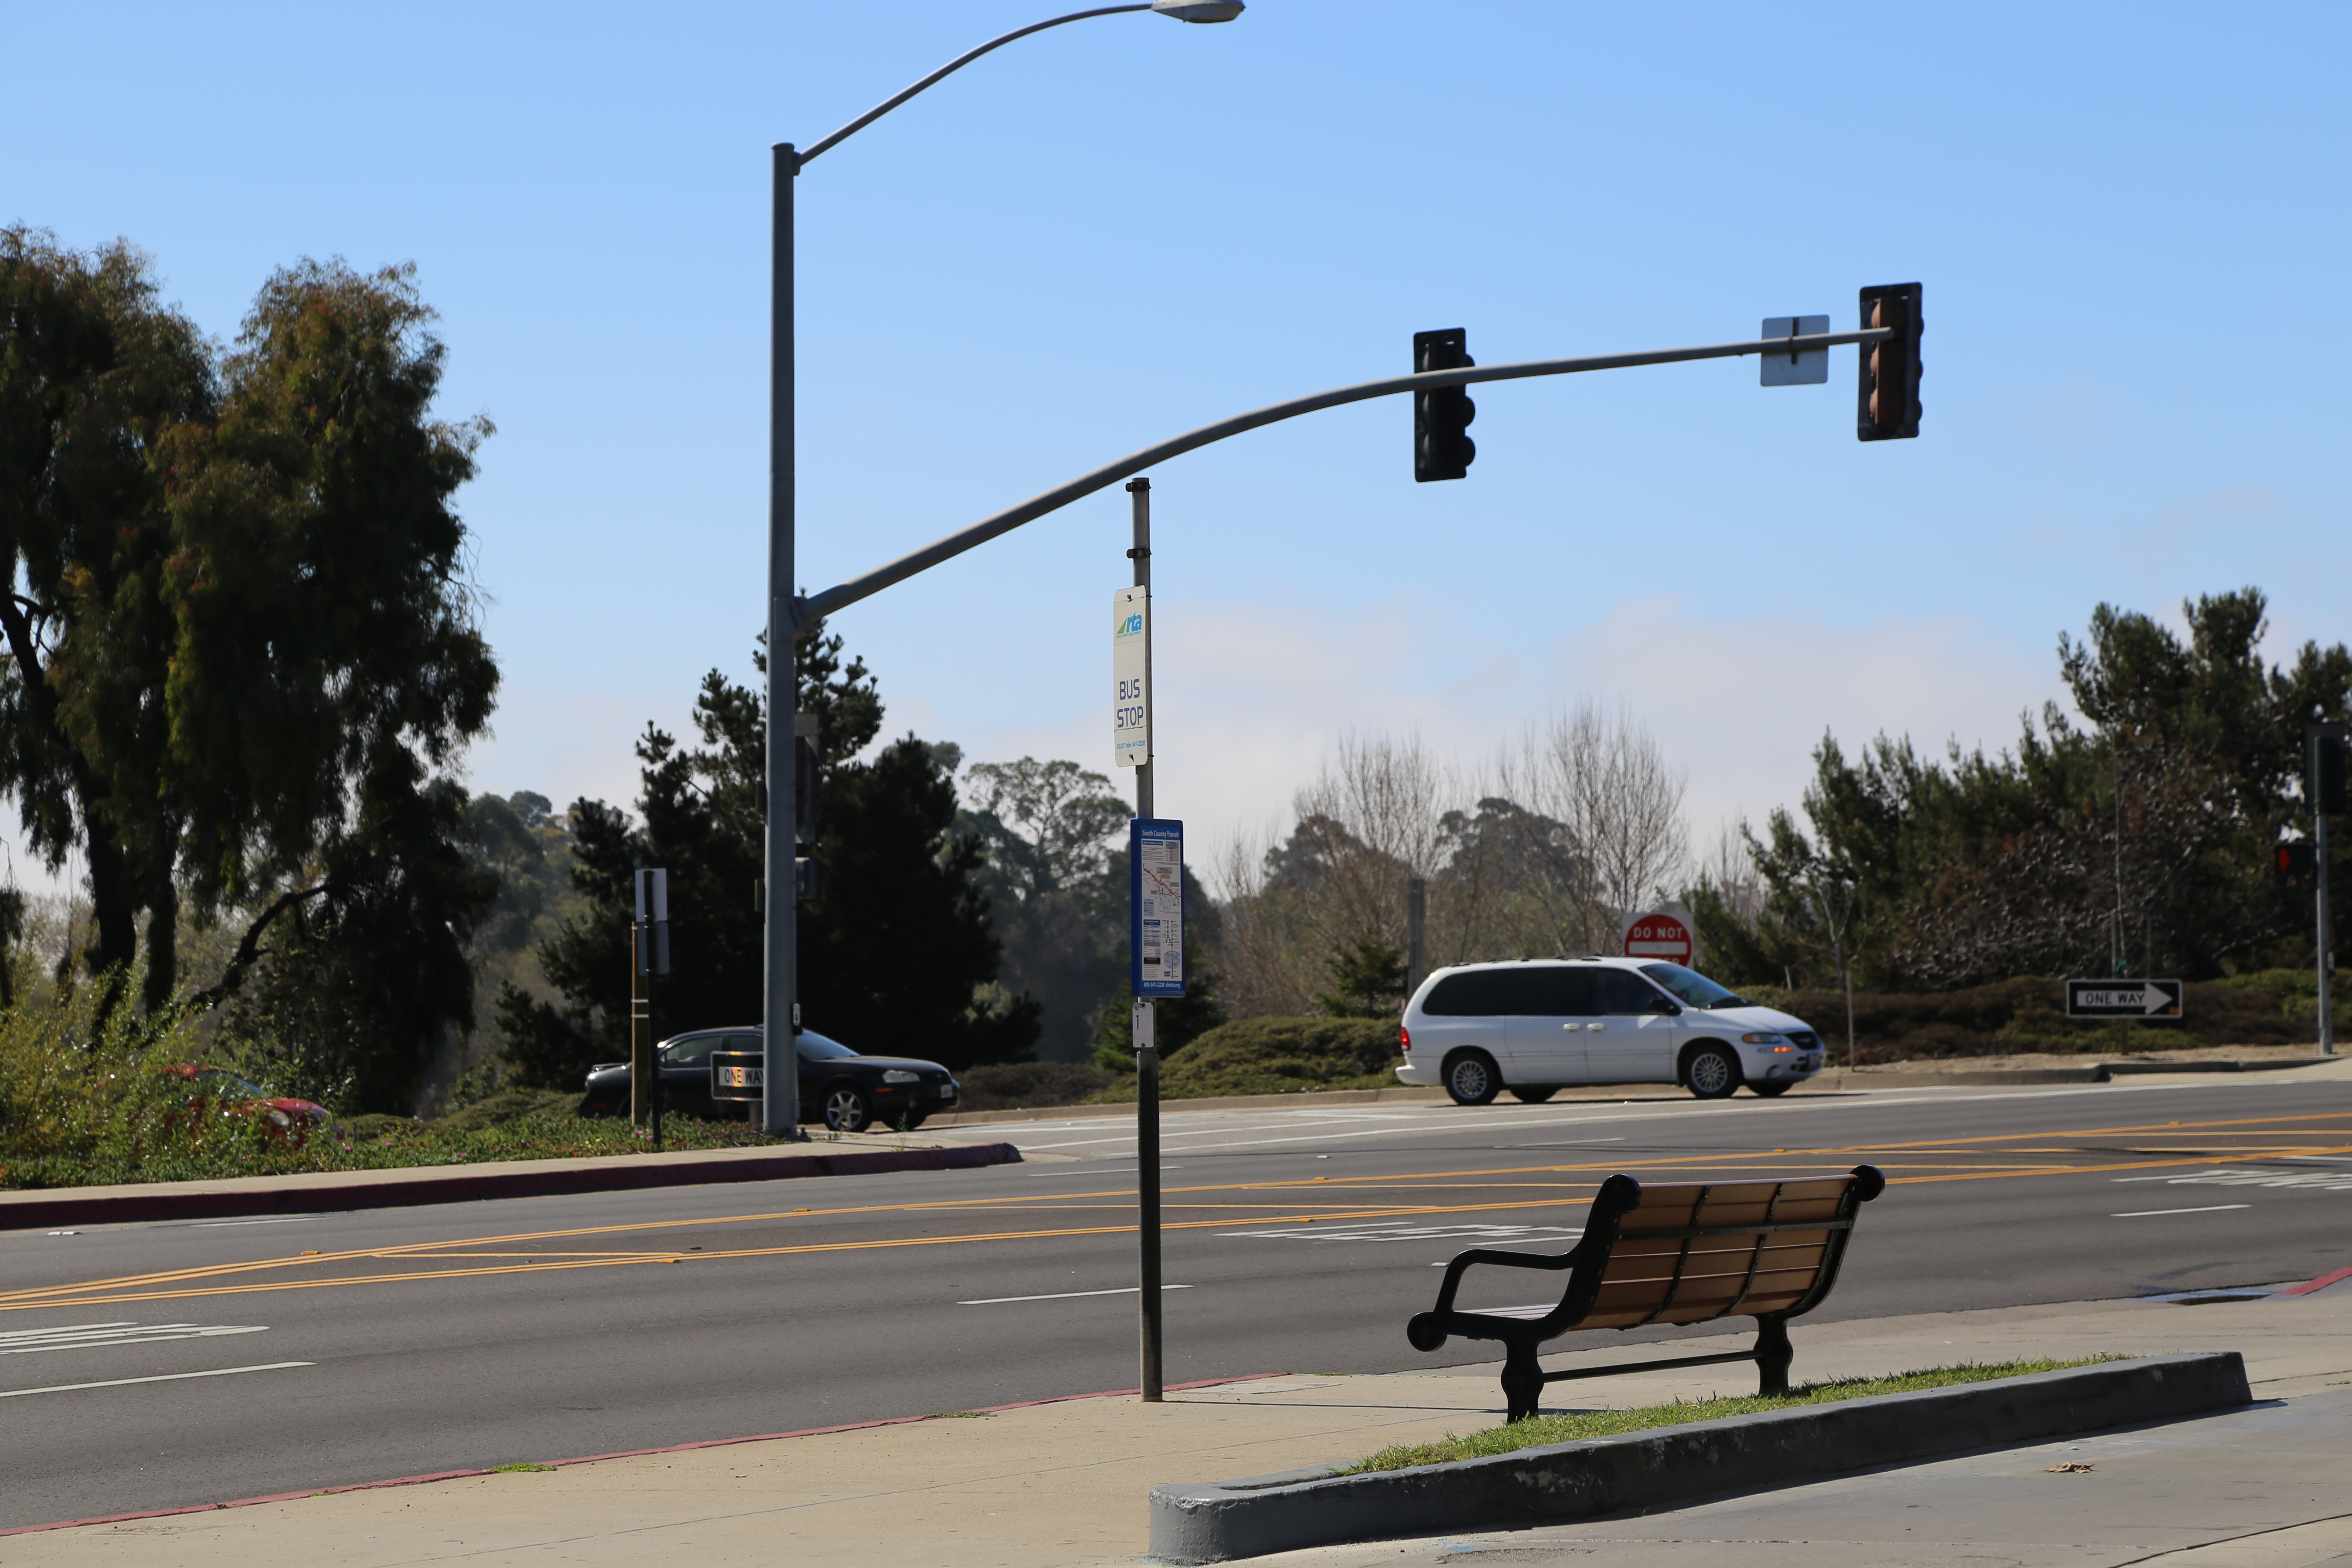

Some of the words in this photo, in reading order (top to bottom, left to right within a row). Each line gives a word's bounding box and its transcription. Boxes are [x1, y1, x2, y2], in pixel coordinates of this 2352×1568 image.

[1127, 612, 1142, 632] rta
[1120, 679, 1140, 700] BUS
[1117, 706, 1143, 728] STOP
[1634, 928, 1651, 938] DO
[1657, 927, 1683, 938] NOT
[2086, 992, 2112, 1004] ONE
[2118, 992, 2144, 1004] WAY
[724, 1069, 742, 1083] ONE
